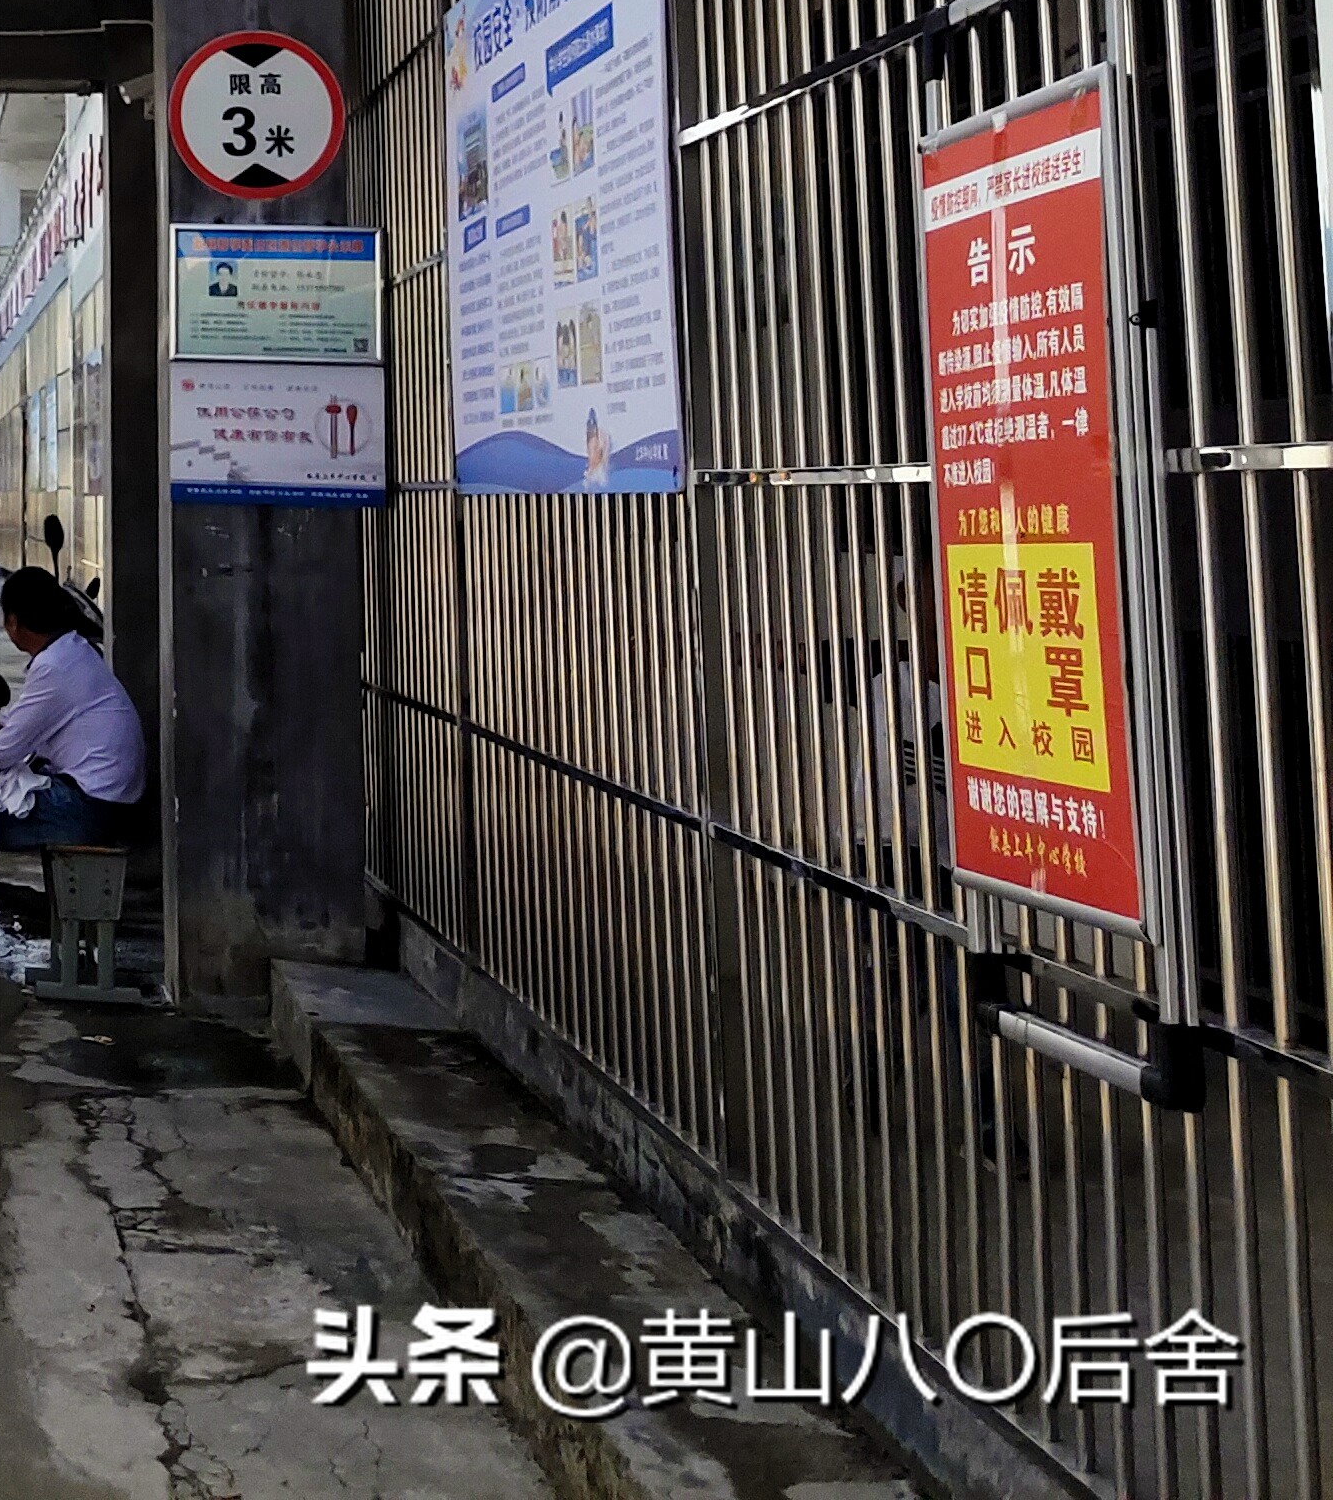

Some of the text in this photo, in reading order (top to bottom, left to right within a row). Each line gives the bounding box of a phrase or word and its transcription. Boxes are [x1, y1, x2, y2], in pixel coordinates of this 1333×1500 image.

[230, 73, 282, 96] 限高
[221, 106, 295, 158] 3米
[967, 225, 1036, 287] 告示
[958, 567, 1085, 639] 请佩戴
[964, 645, 1090, 718] 口罩
[964, 711, 1096, 765] 进入校园
